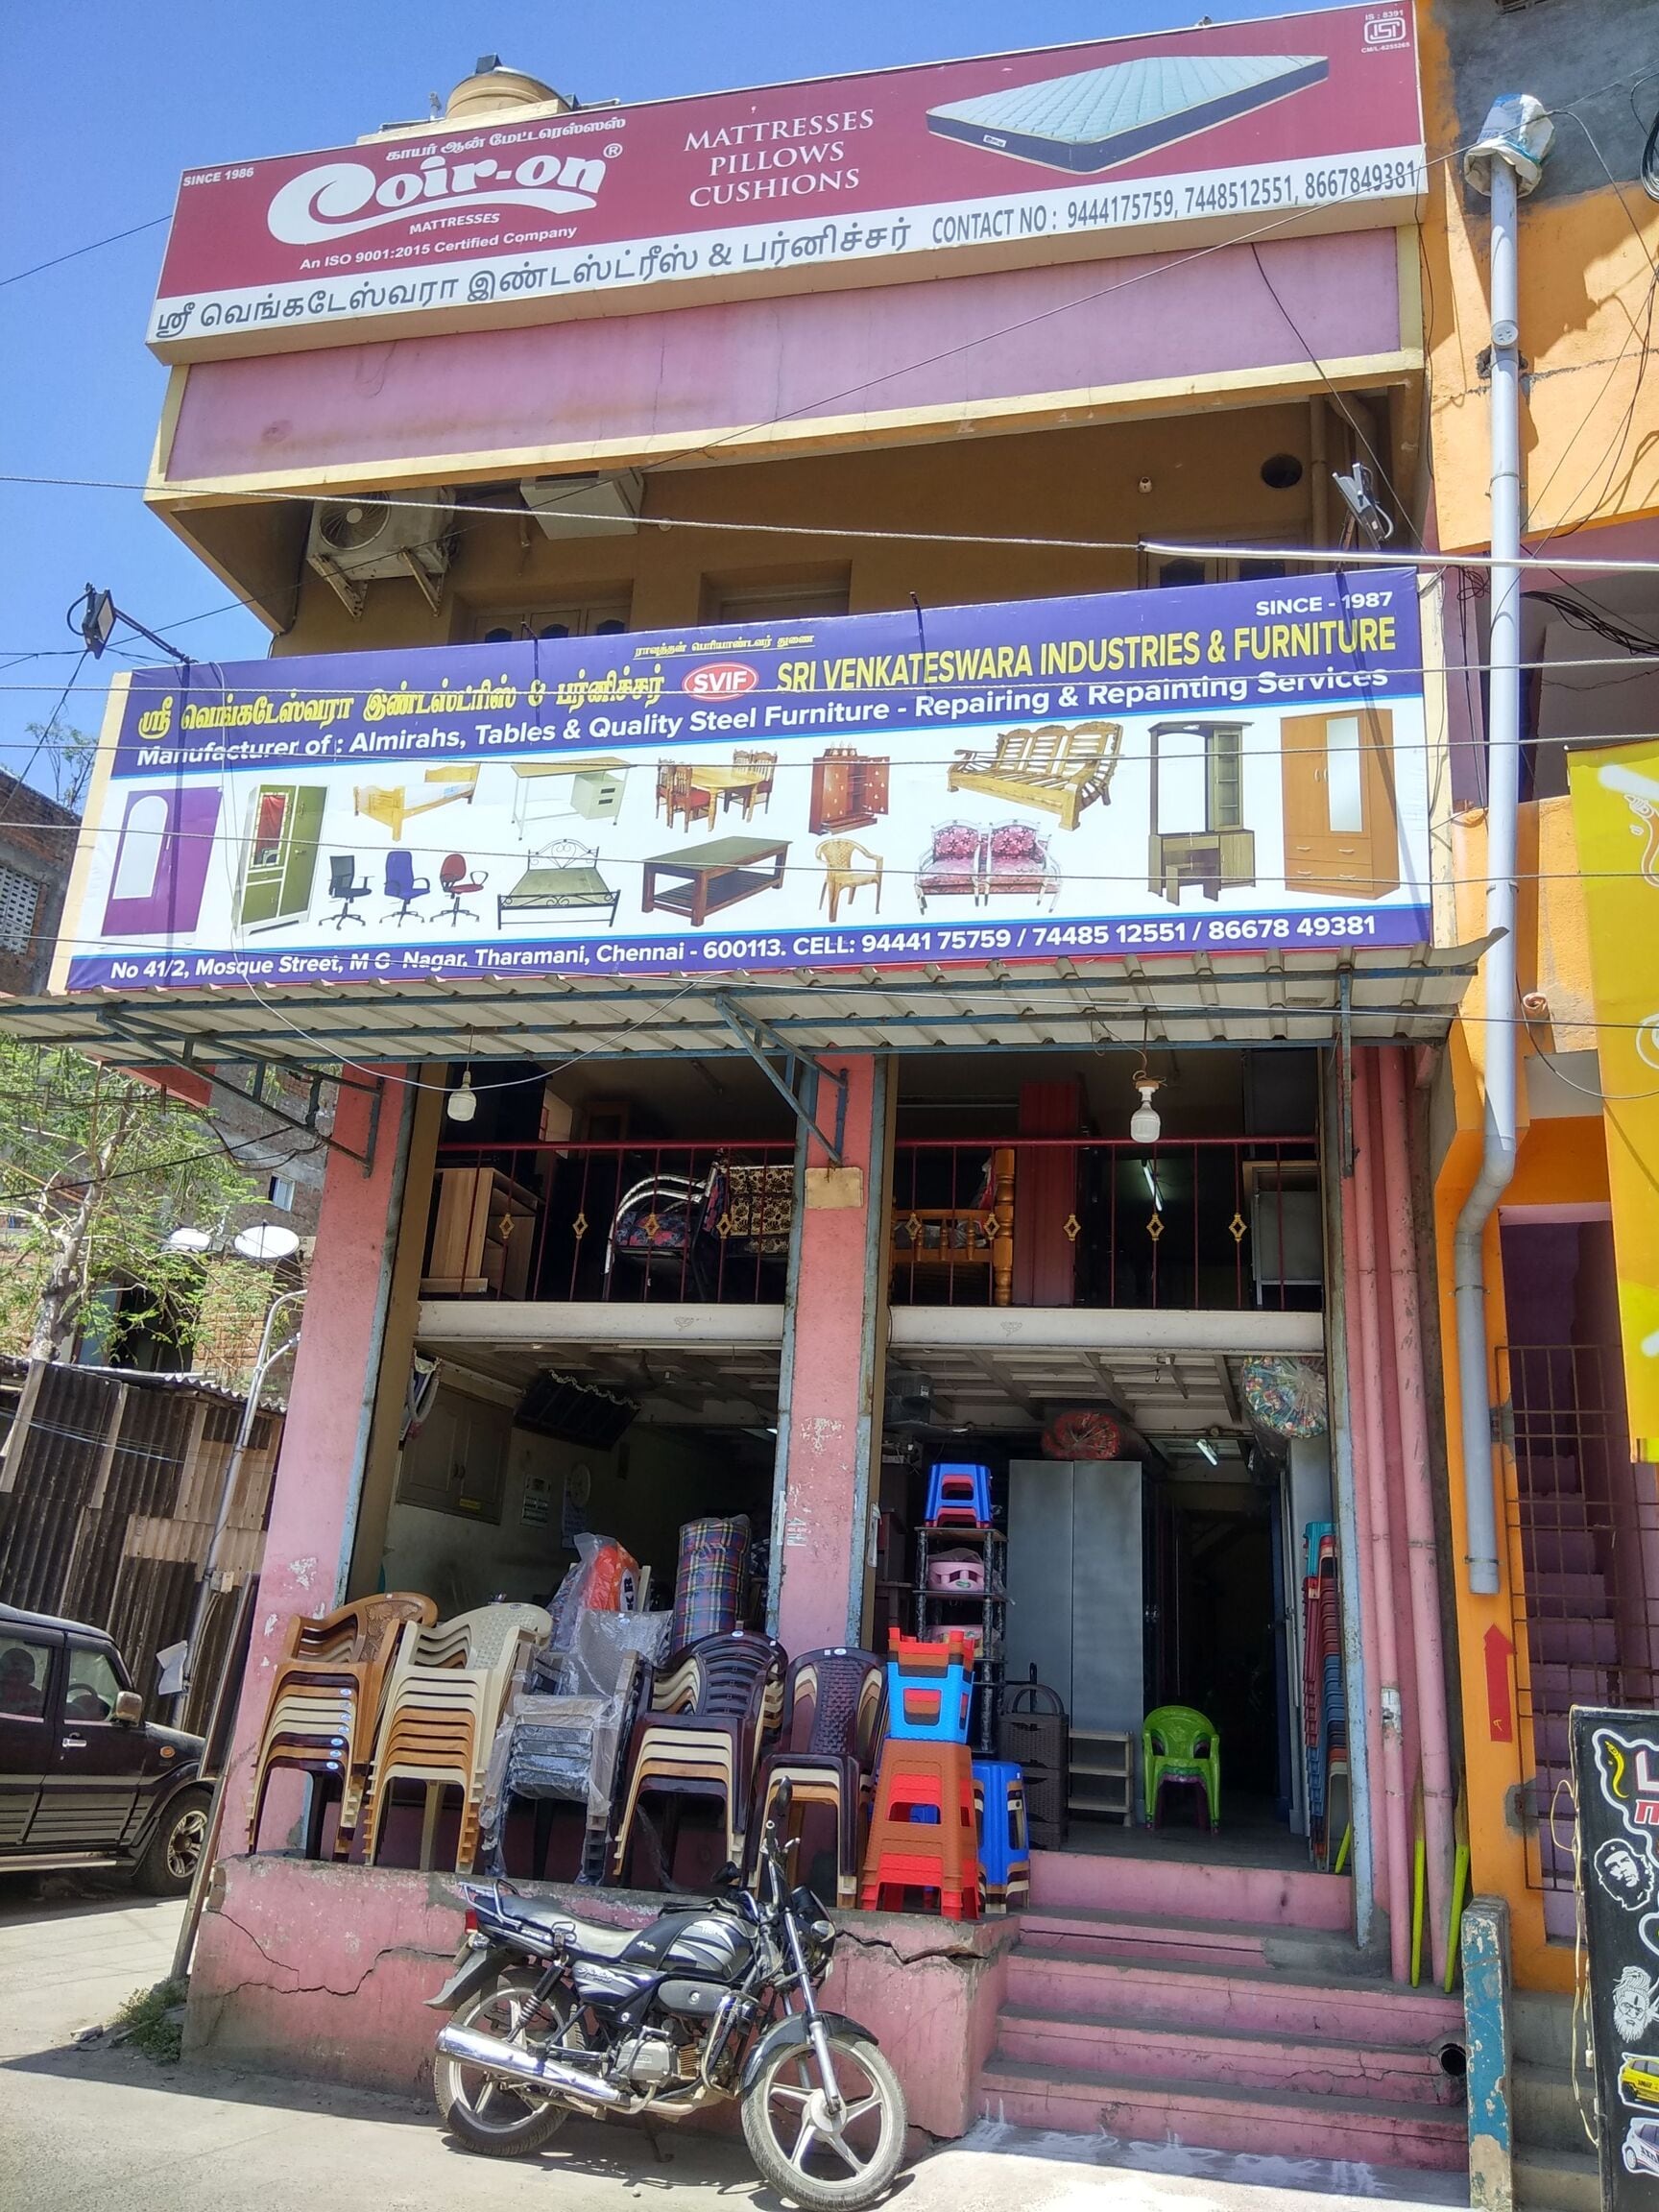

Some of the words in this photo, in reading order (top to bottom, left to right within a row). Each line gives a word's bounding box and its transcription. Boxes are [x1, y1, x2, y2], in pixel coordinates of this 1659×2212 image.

[386, 143, 437, 161] காயர்
[441, 137, 484, 154] ஆன்
[684, 108, 874, 152] MATTRESSES
[182, 171, 221, 187] SINCE
[225, 167, 254, 181] 1986
[709, 141, 844, 177] PILLOWS
[689, 168, 859, 207] CUSHIONS
[932, 208, 1015, 244] CONTACT
[1020, 204, 1047, 233] NO
[1305, 159, 1416, 200] 8667849381
[409, 213, 500, 235] MATTRESSES
[299, 257, 321, 271] An
[325, 253, 351, 267] ISO
[355, 242, 431, 264] 9001:2015
[434, 233, 498, 253] Certified
[503, 227, 578, 246] Company
[200, 277, 459, 327] வெங்கடேஸ்வரா
[467, 243, 699, 302] இண்டஸ்ட்ரீஸ்
[709, 243, 732, 267] &
[743, 216, 911, 268] பர்னிச்சர்
[1256, 596, 1322, 616] SINCE
[1342, 591, 1393, 610] 1987
[777, 661, 816, 692] SRI
[824, 644, 1033, 690] VENKATESWARA
[1040, 629, 1200, 675] INDUSTRIES
[1207, 629, 1226, 663] &
[1234, 616, 1396, 661] FURNITURE
[693, 671, 748, 692] SVIF
[136, 739, 298, 767] Manufacturer
[301, 733, 332, 756] of
[349, 727, 468, 754] Almirahs,
[475, 721, 556, 746] Tables
[563, 719, 581, 739] &
[589, 712, 683, 739] Quality
[689, 708, 757, 732] Steel
[765, 699, 889, 727] Furniture
[914, 689, 1050, 720] Repairing
[1058, 685, 1079, 708] &
[1088, 676, 1248, 709] Repainting
[1258, 666, 1388, 694] Services
[110, 961, 138, 979] No
[143, 959, 190, 980] 41/2,
[195, 957, 273, 981] Mosque
[278, 953, 344, 975] Street,
[475, 943, 590, 967] Tharamani,
[596, 940, 685, 963] Chennai
[793, 935, 855, 956] CELL:
[861, 932, 930, 953] 94441
[937, 928, 1009, 950] 75759
[1032, 925, 1110, 947] 74485
[1116, 922, 1186, 944] 12551
[1208, 918, 1290, 941] 86678
[1296, 915, 1376, 938] 49381
